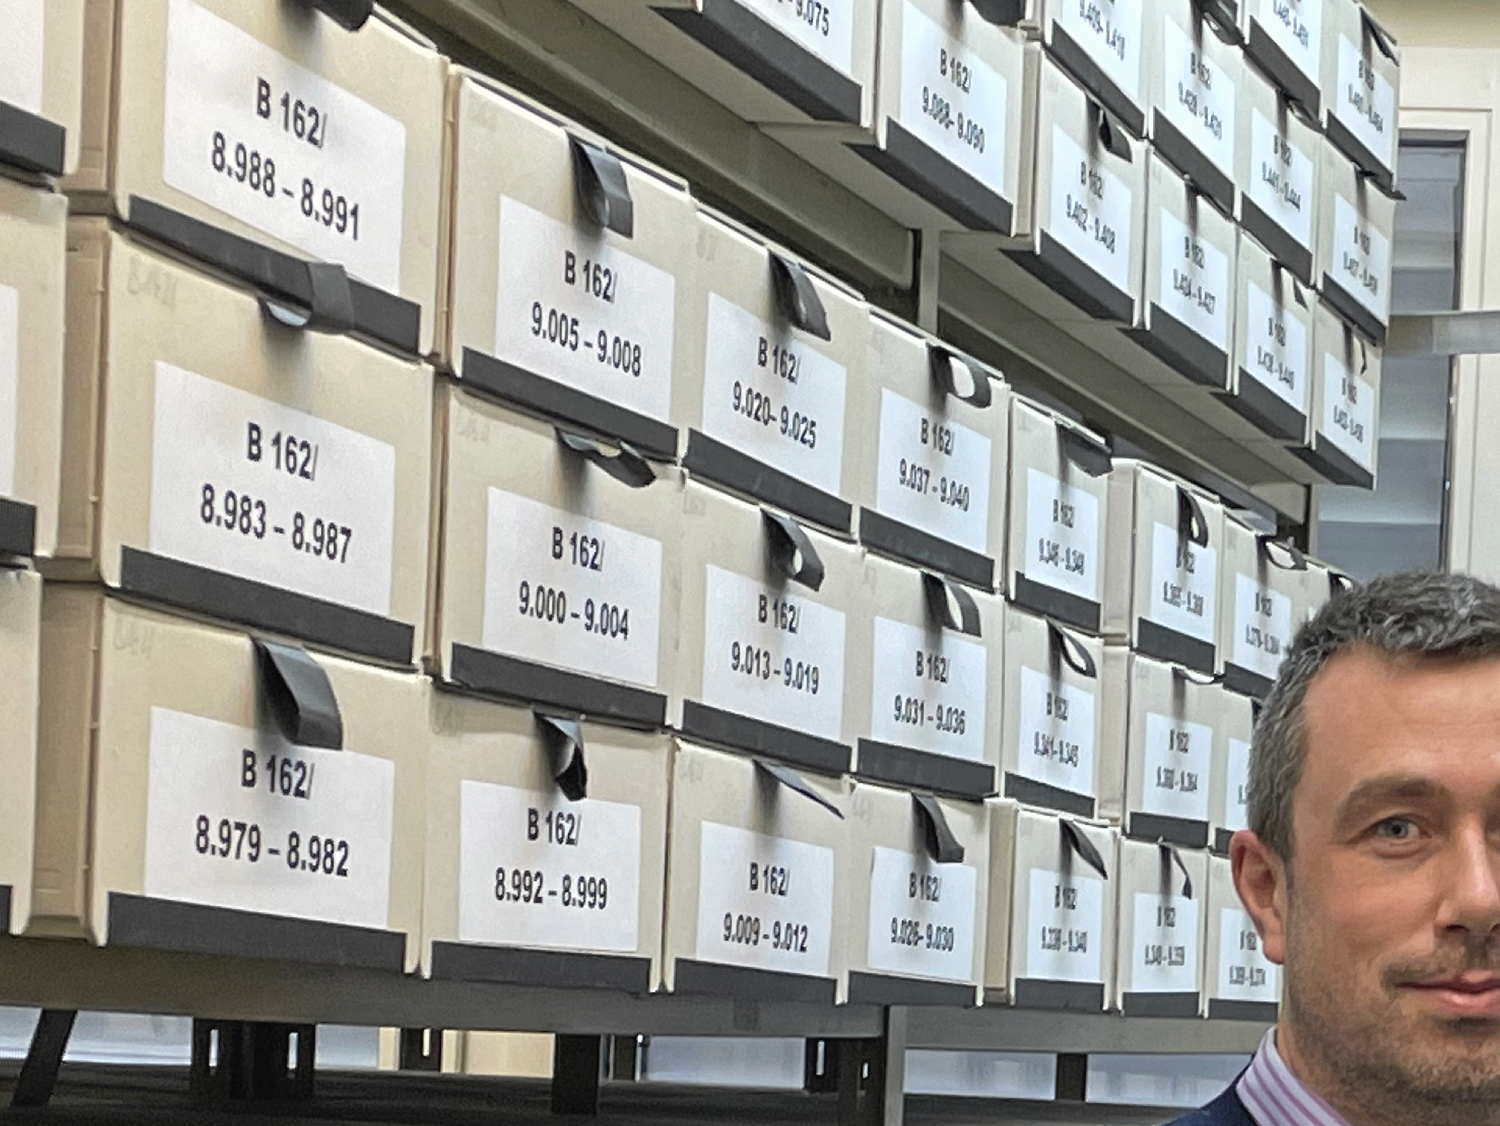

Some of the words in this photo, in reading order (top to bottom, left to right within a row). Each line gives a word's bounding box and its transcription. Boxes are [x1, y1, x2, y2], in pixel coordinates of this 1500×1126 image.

[940, 48, 947, 76] B
[257, 77, 271, 119] B
[281, 90, 327, 149] 162/
[212, 131, 275, 198] 8.988
[301, 178, 359, 241] 8.991
[565, 250, 576, 285] B
[583, 256, 617, 303] 162/
[532, 302, 579, 351] 9.005
[598, 330, 641, 377] 9.008
[758, 337, 768, 367] B
[773, 344, 801, 385] 162/
[780, 405, 816, 449] 9.025
[921, 418, 929, 444] B
[247, 422, 262, 462] B
[271, 431, 318, 481] 162/
[899, 458, 930, 494] 9.037
[201, 483, 266, 539] 8.983
[292, 513, 352, 563] 8.987
[552, 526, 563, 560] B
[569, 530, 605, 571] 162/
[519, 581, 566, 624] 9.000
[584, 598, 629, 641] 9.004
[758, 594, 767, 623] B
[773, 599, 802, 634] 162/
[732, 641, 770, 680] 9.013
[784, 658, 819, 694] 9.019
[916, 650, 924, 677] B
[894, 695, 924, 726] 9.031
[241, 749, 256, 788] B
[266, 755, 315, 800] 162/
[195, 815, 261, 862] 8.979
[287, 831, 348, 877] 8.982
[528, 808, 539, 841] B
[545, 810, 582, 846] 162/
[495, 867, 543, 904] 8.992
[562, 874, 607, 910] 8.999
[750, 862, 758, 891] B
[763, 864, 790, 897] 162/
[909, 872, 917, 898] B
[723, 912, 760, 946] 9.009
[773, 921, 808, 953] 9.012
